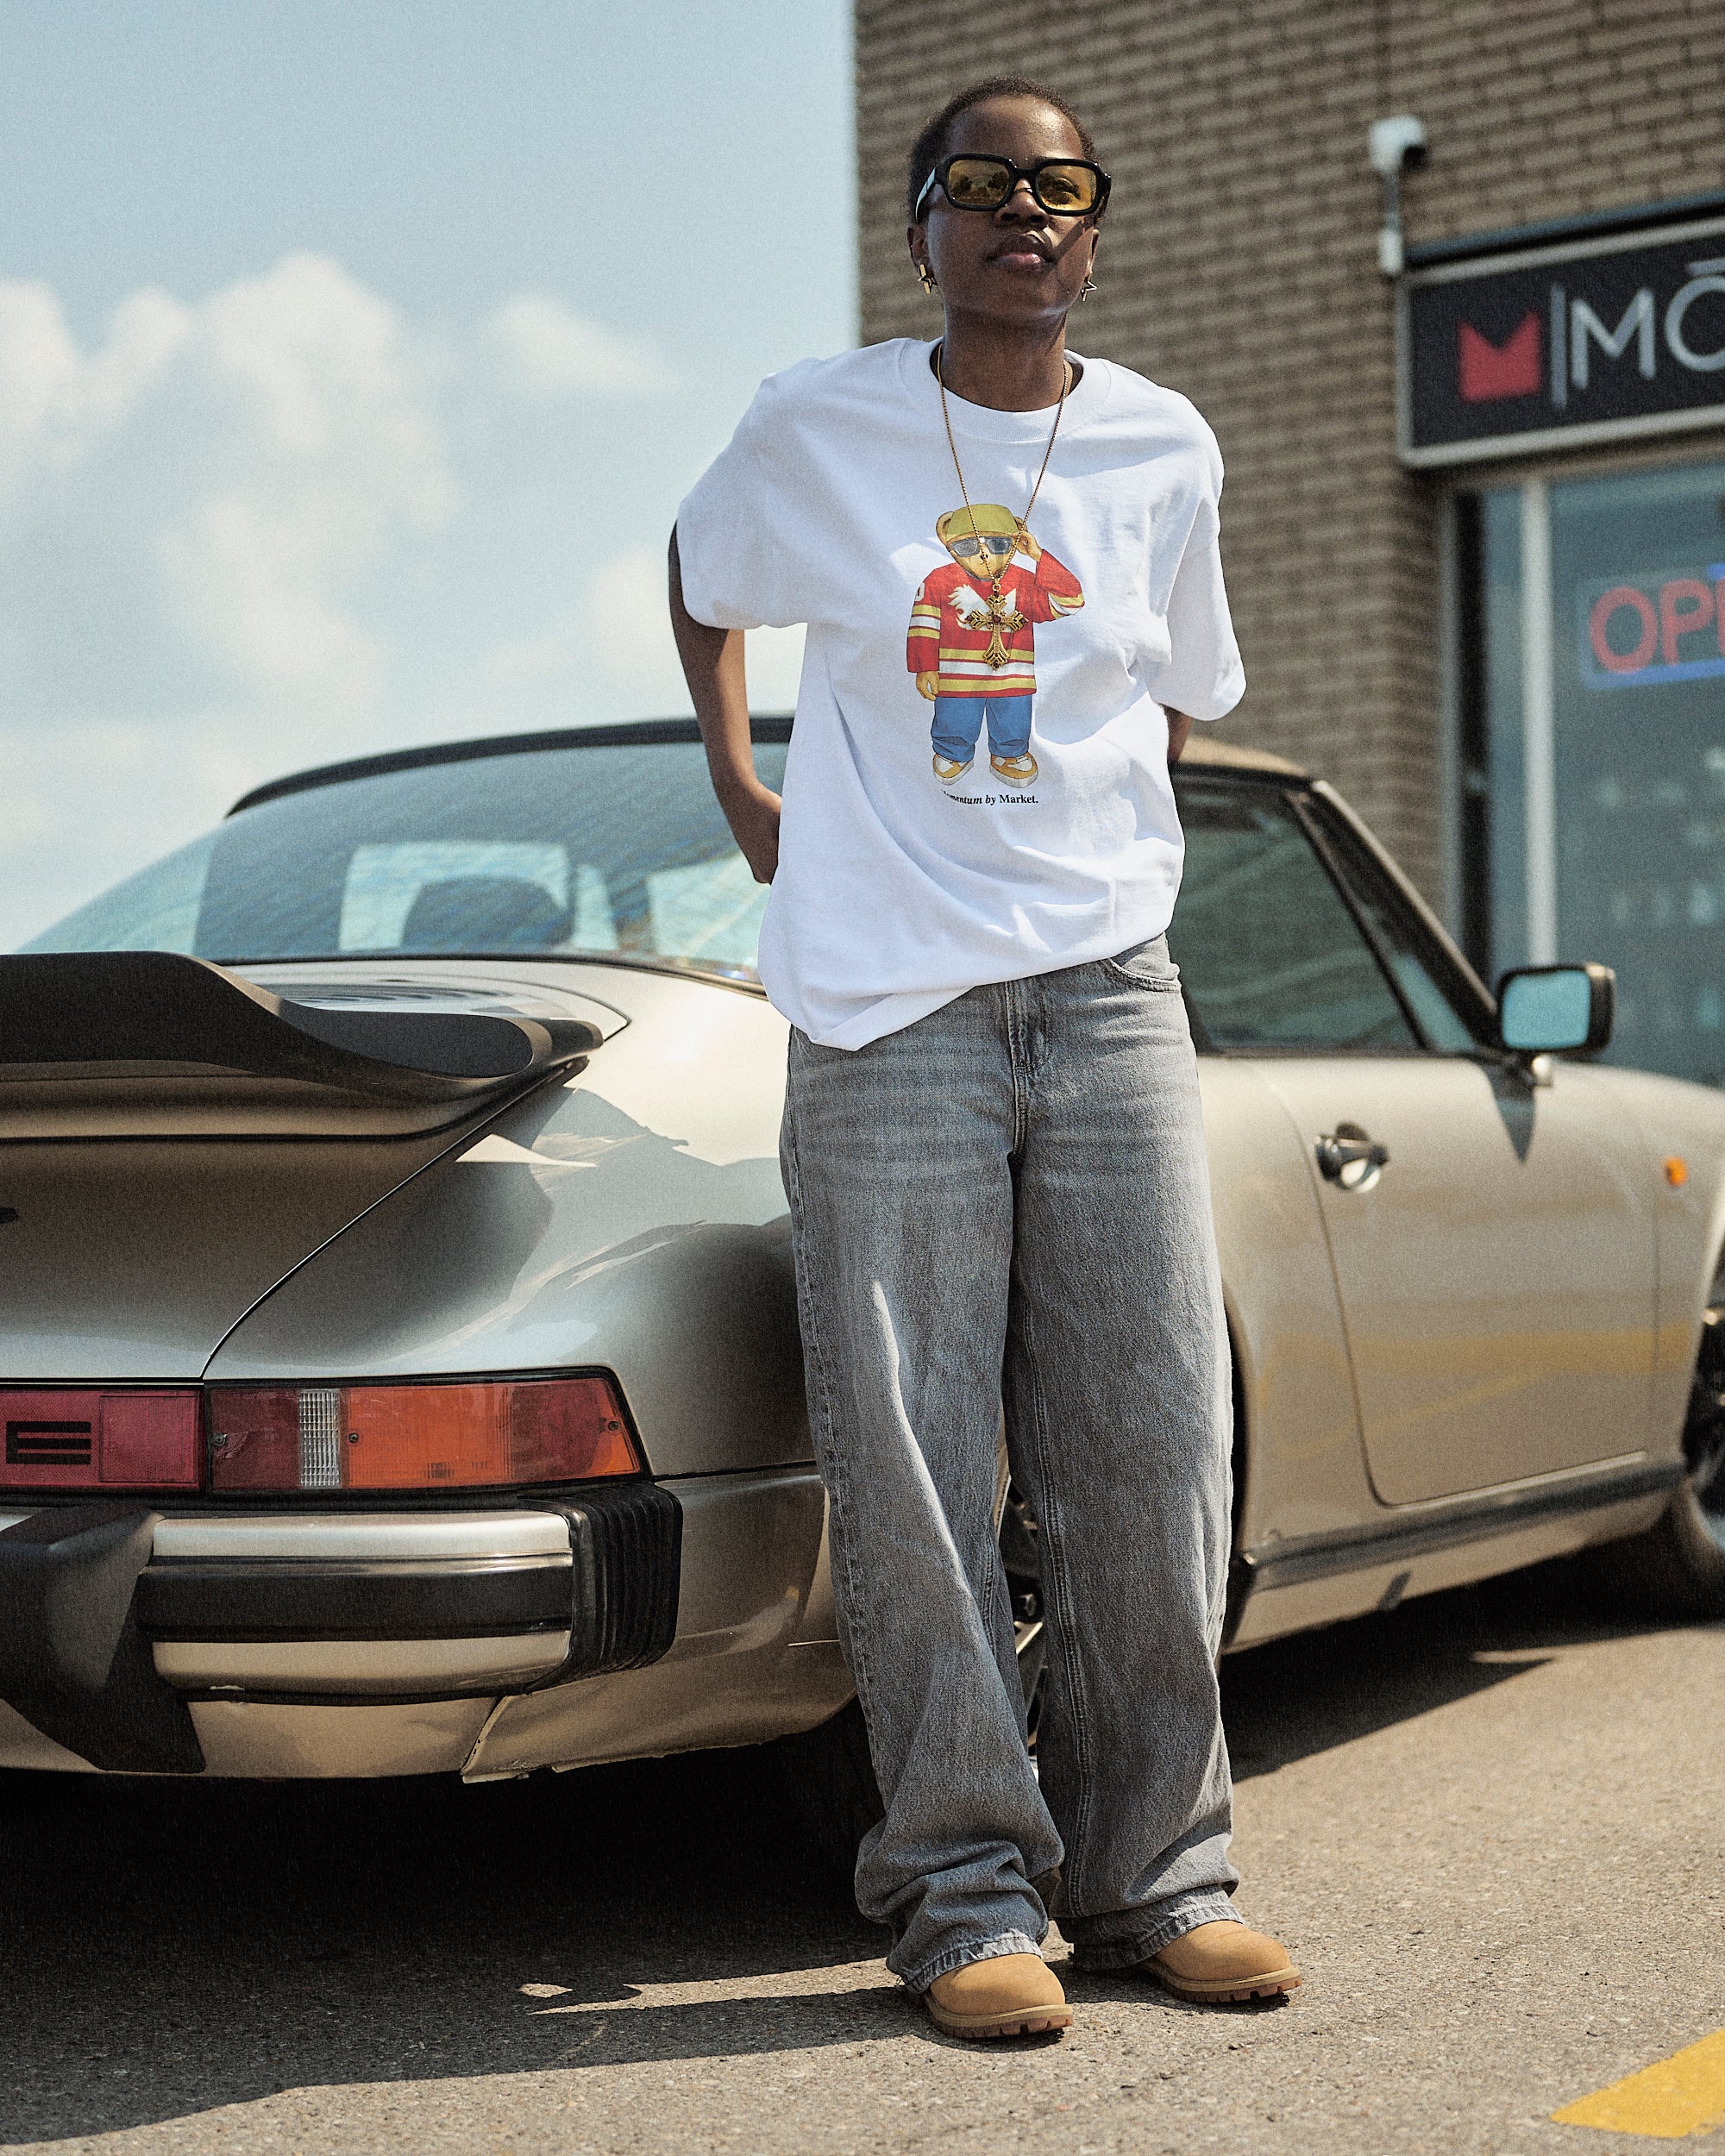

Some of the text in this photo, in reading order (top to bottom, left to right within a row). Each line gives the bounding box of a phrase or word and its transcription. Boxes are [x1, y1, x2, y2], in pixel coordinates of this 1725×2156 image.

[1589, 578, 1725, 674] OP
[985, 794, 996, 806] by
[999, 794, 1038, 804] Market.
